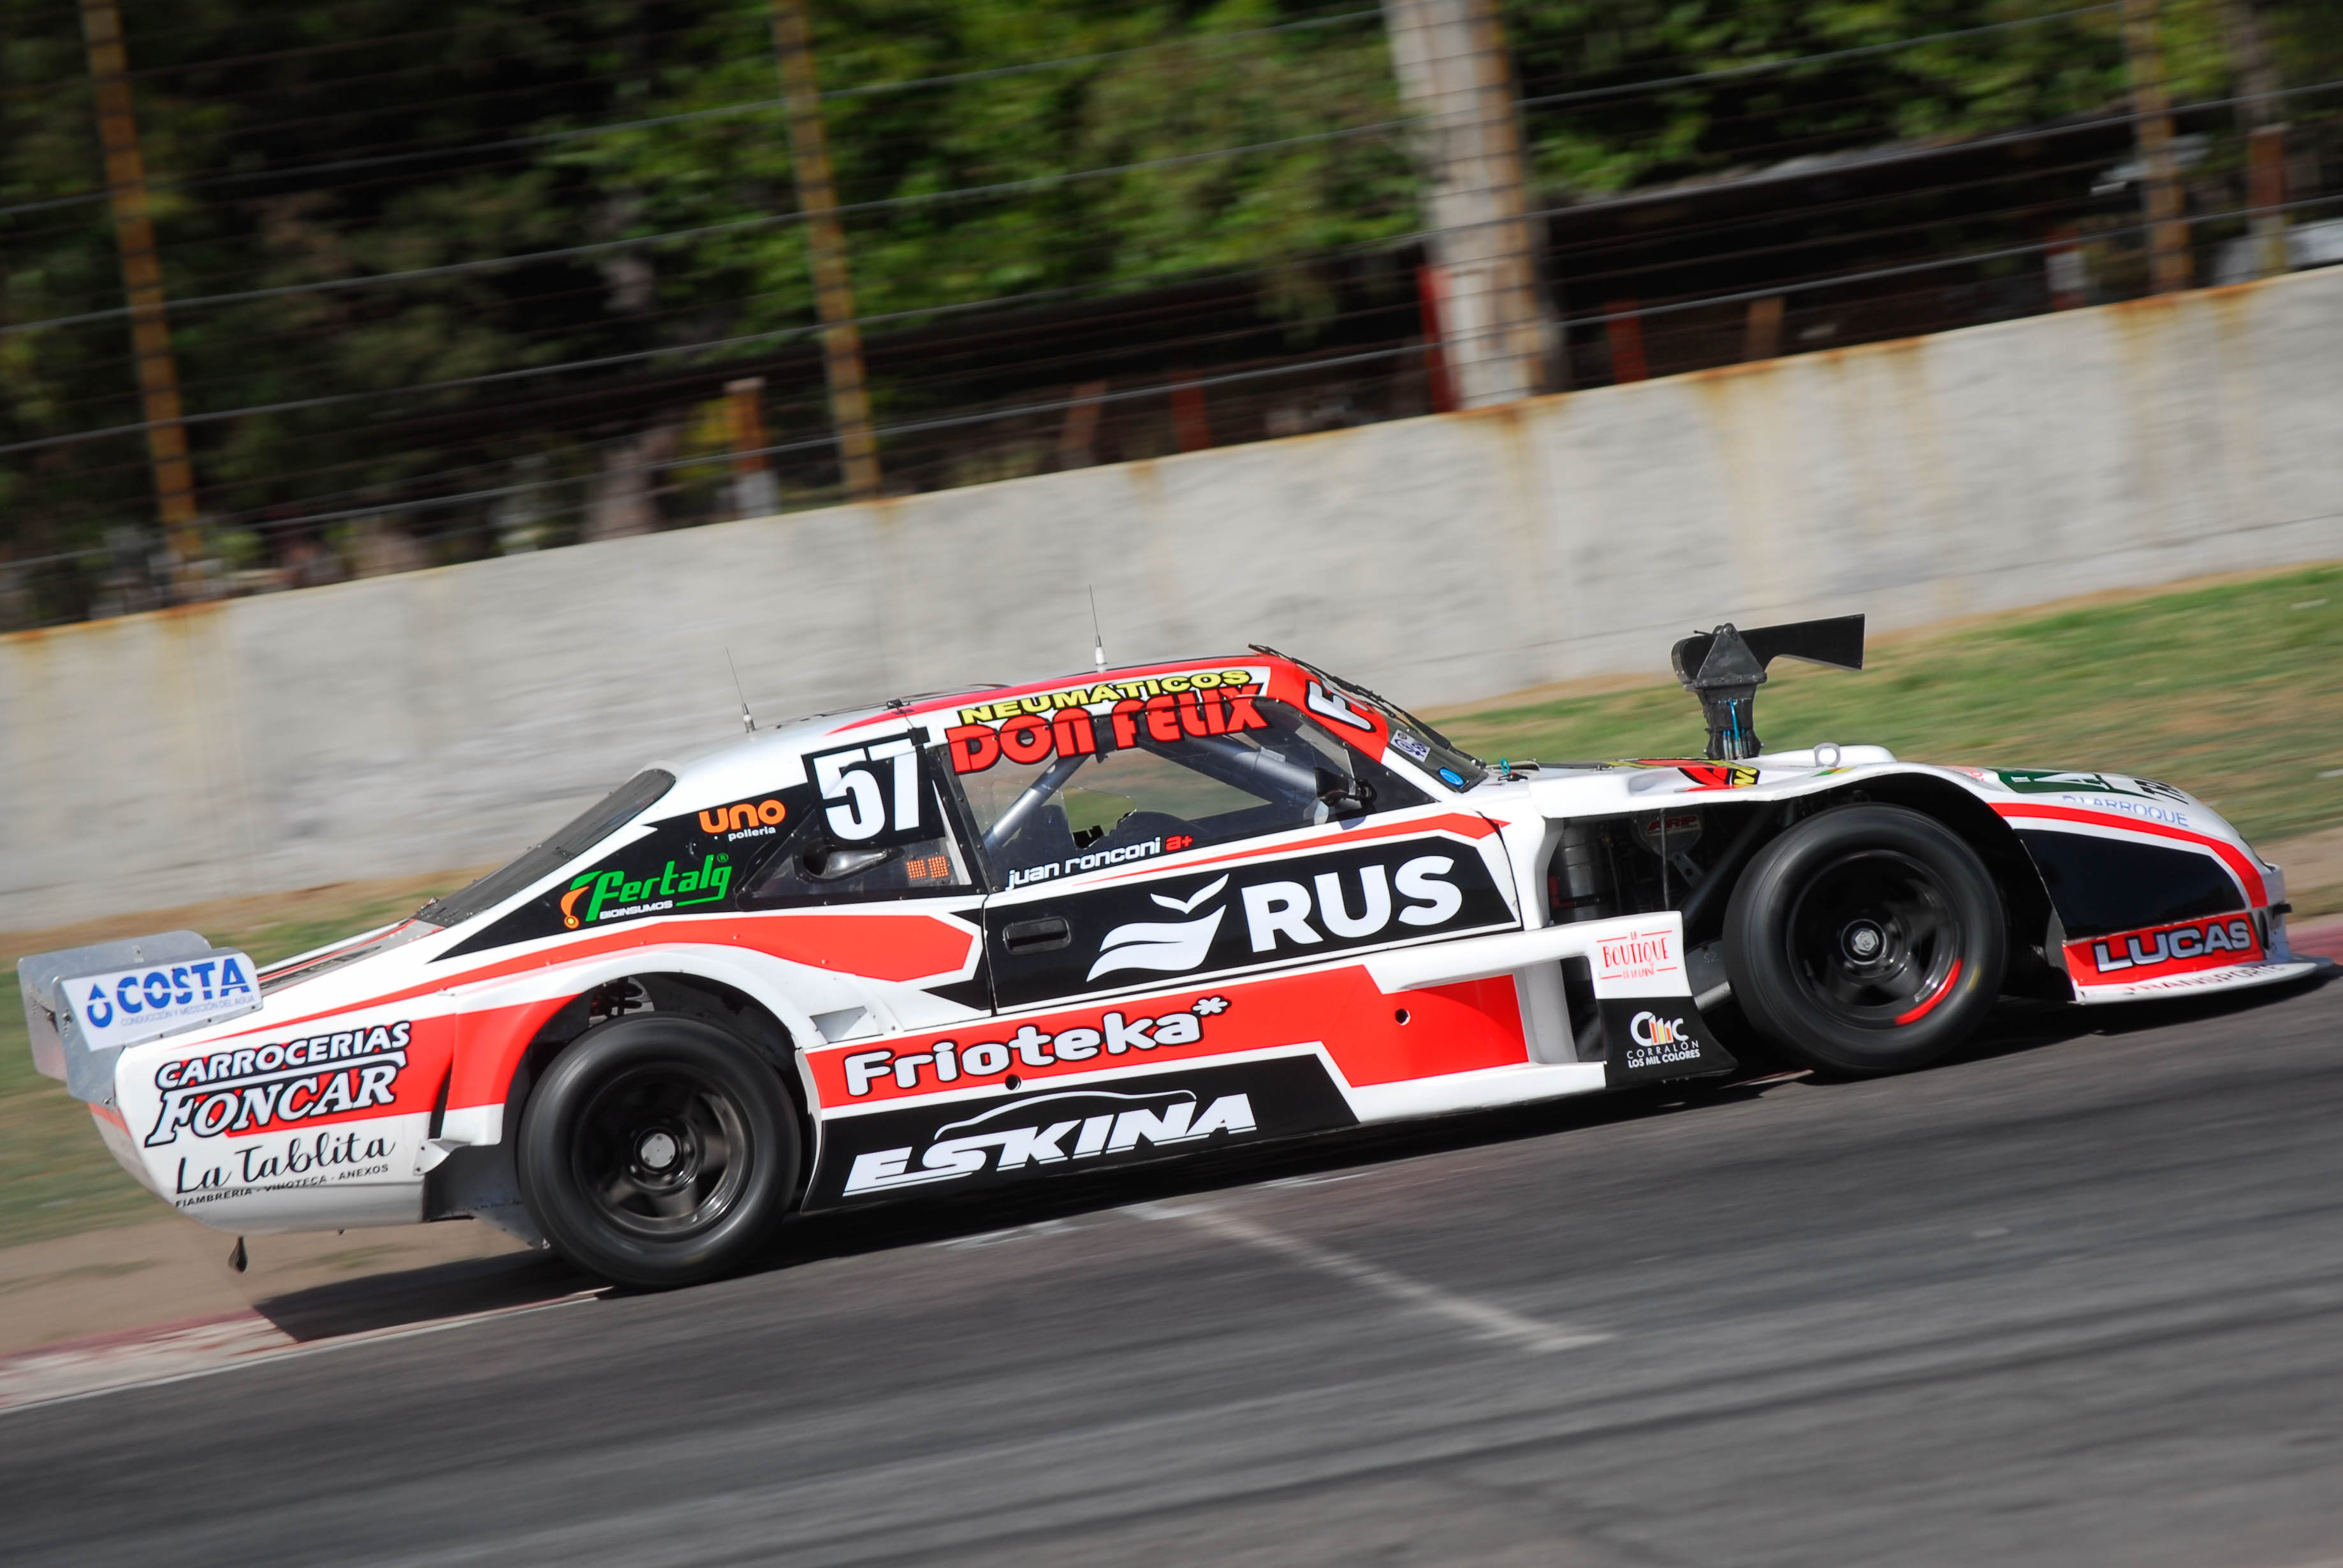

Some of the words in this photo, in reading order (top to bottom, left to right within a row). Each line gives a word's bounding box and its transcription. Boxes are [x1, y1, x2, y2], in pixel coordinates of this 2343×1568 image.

[960, 670, 1251, 723] NEUMÁTICOS
[946, 708, 1099, 775] DON
[1113, 683, 1271, 750] FELIX
[813, 737, 920, 840] 57
[1005, 862, 1061, 892] juan
[1065, 837, 1161, 874] ronconi
[599, 900, 673, 920] BIOINSUMOS
[1241, 855, 1463, 954] RUS
[1603, 937, 1670, 968] BOUTIQUE
[2094, 918, 2252, 973] LUCAS
[117, 957, 251, 1013] COSTA
[156, 1021, 411, 1090] CARROCERIAS
[1628, 1058, 1645, 1069] LOS
[1646, 1055, 1661, 1066] MIL
[1661, 1049, 1700, 1063] COLORES
[145, 1053, 407, 1146] FONCAR
[176, 1157, 232, 1194] La
[235, 1132, 397, 1183] Tablita
[842, 1093, 1257, 1197] ESKINA
[175, 1187, 253, 1209] FIAMBRERIA
[338, 1164, 389, 1180] ANEXOS
